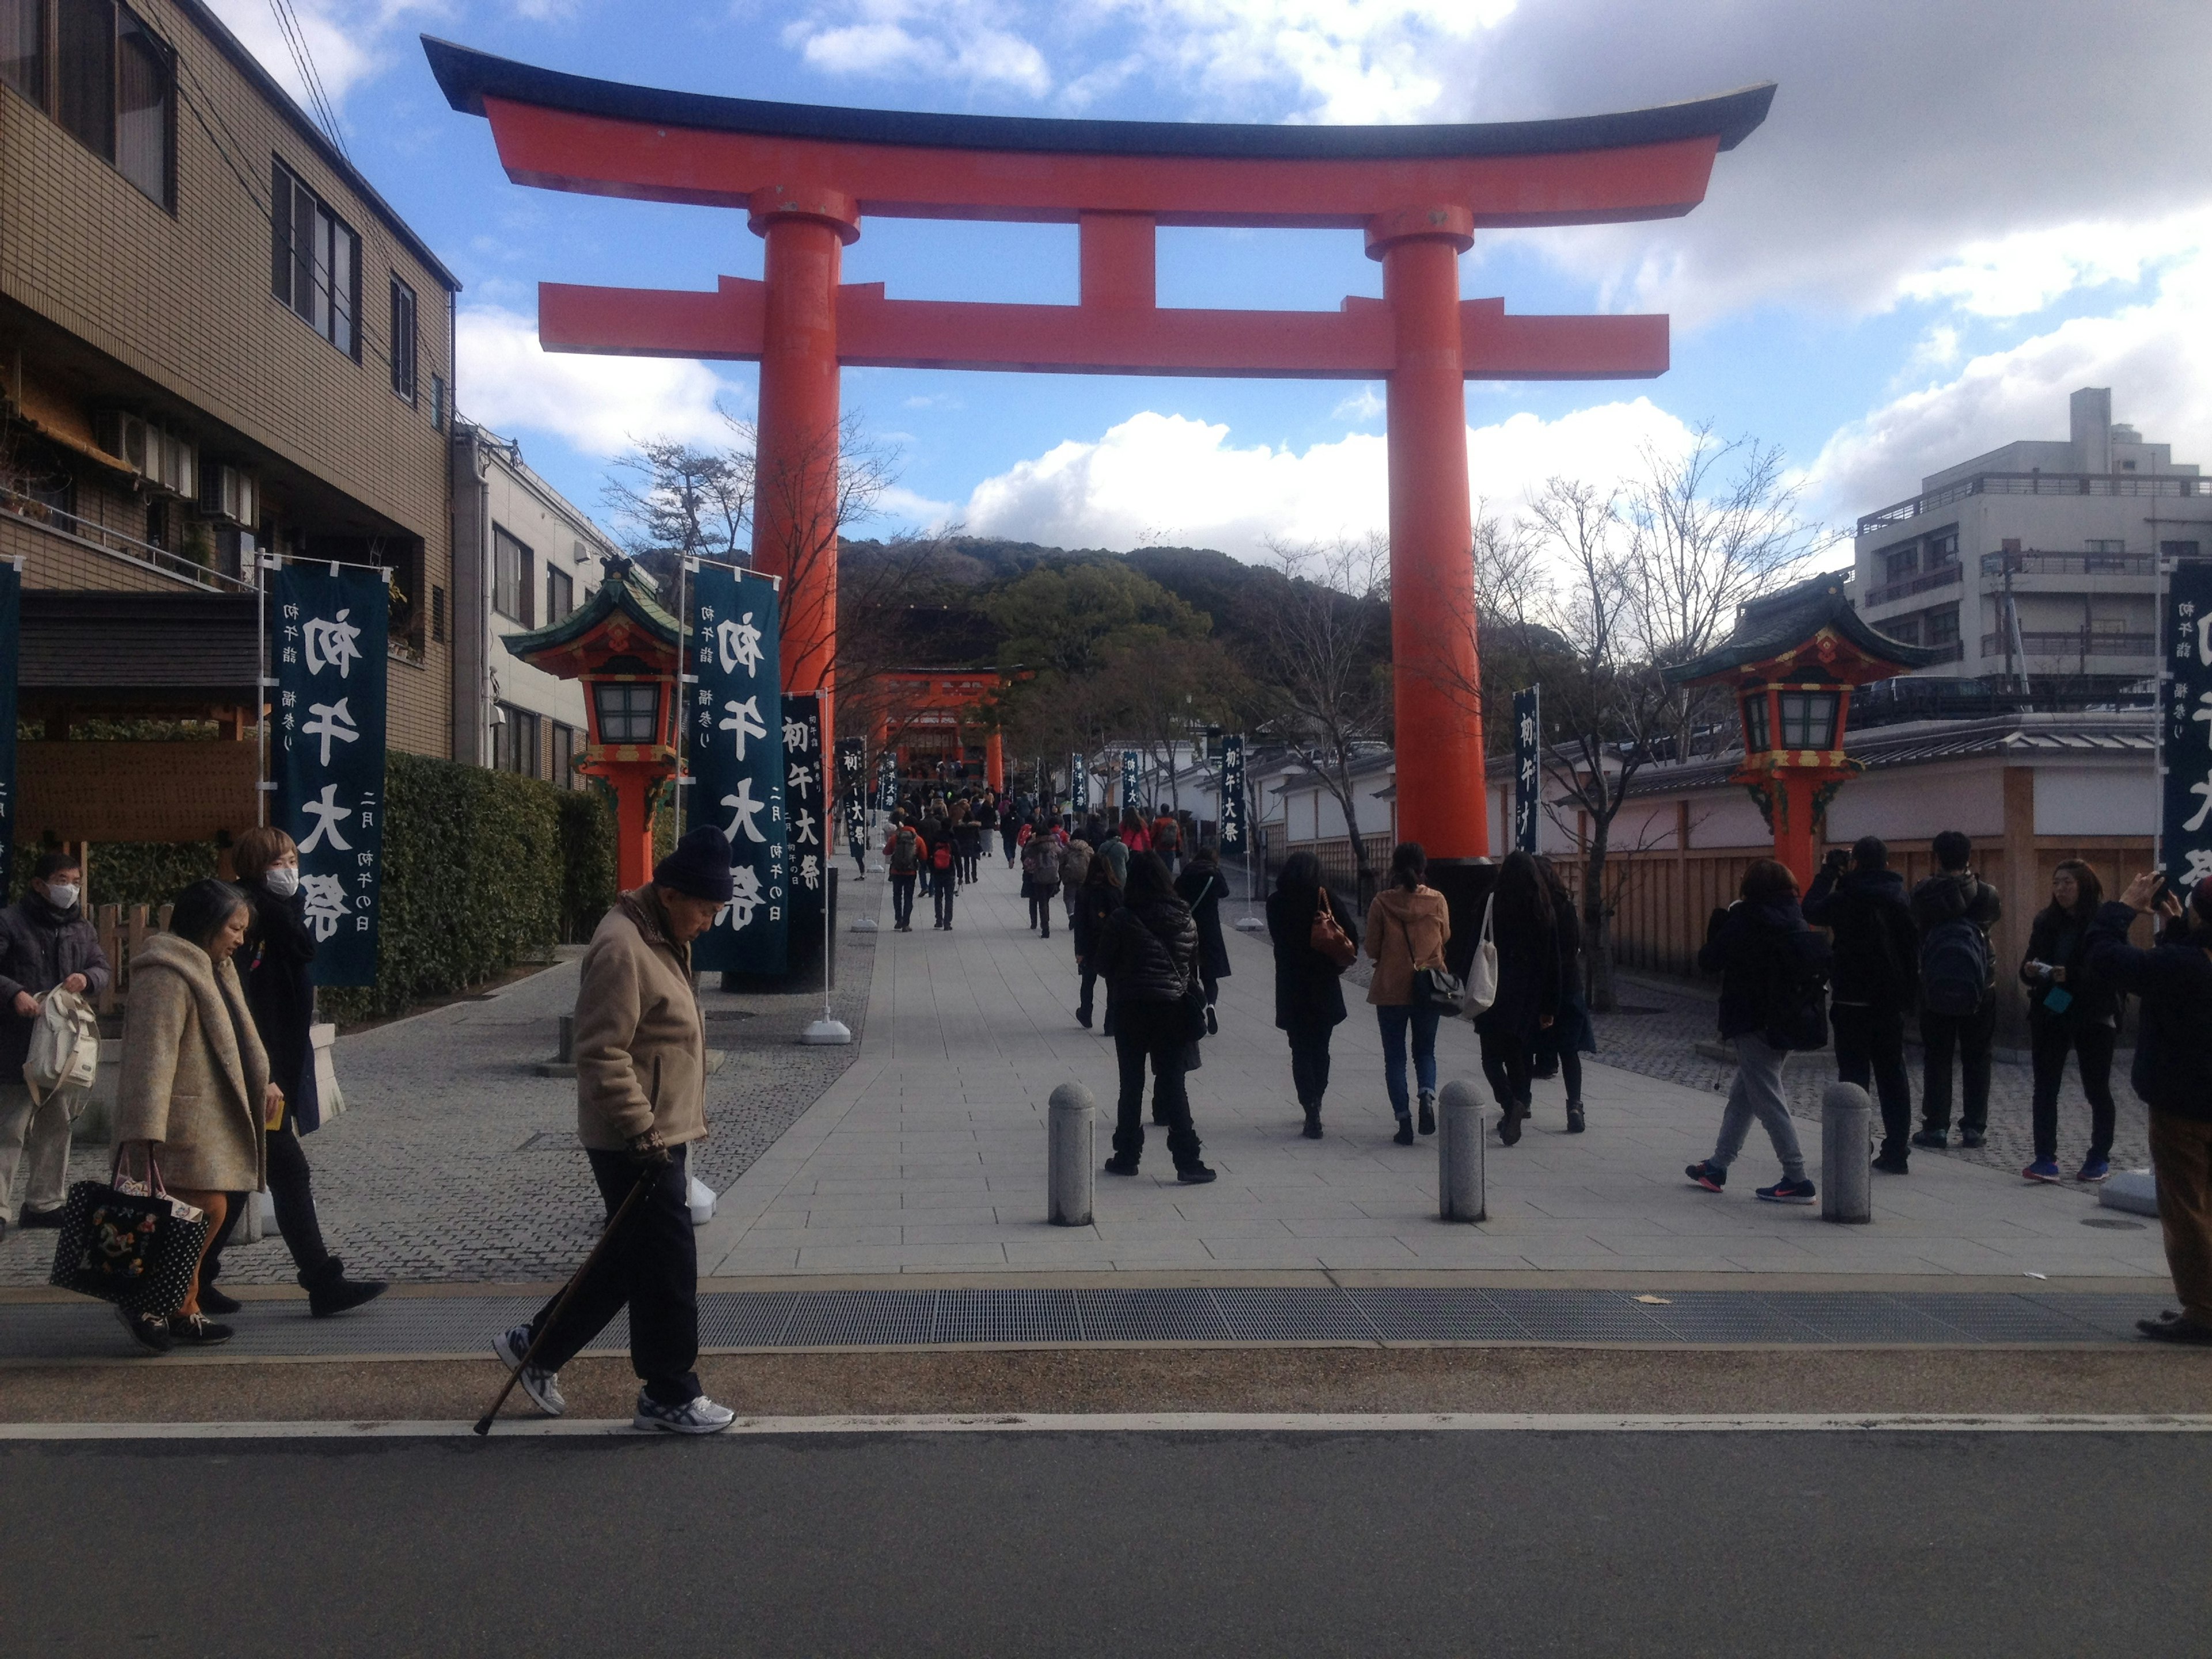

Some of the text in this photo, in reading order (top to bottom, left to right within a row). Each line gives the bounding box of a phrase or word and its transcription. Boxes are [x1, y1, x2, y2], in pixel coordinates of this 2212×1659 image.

[781, 716, 820, 891] 初午大祭
[1225, 748, 1238, 842] 初午大祭
